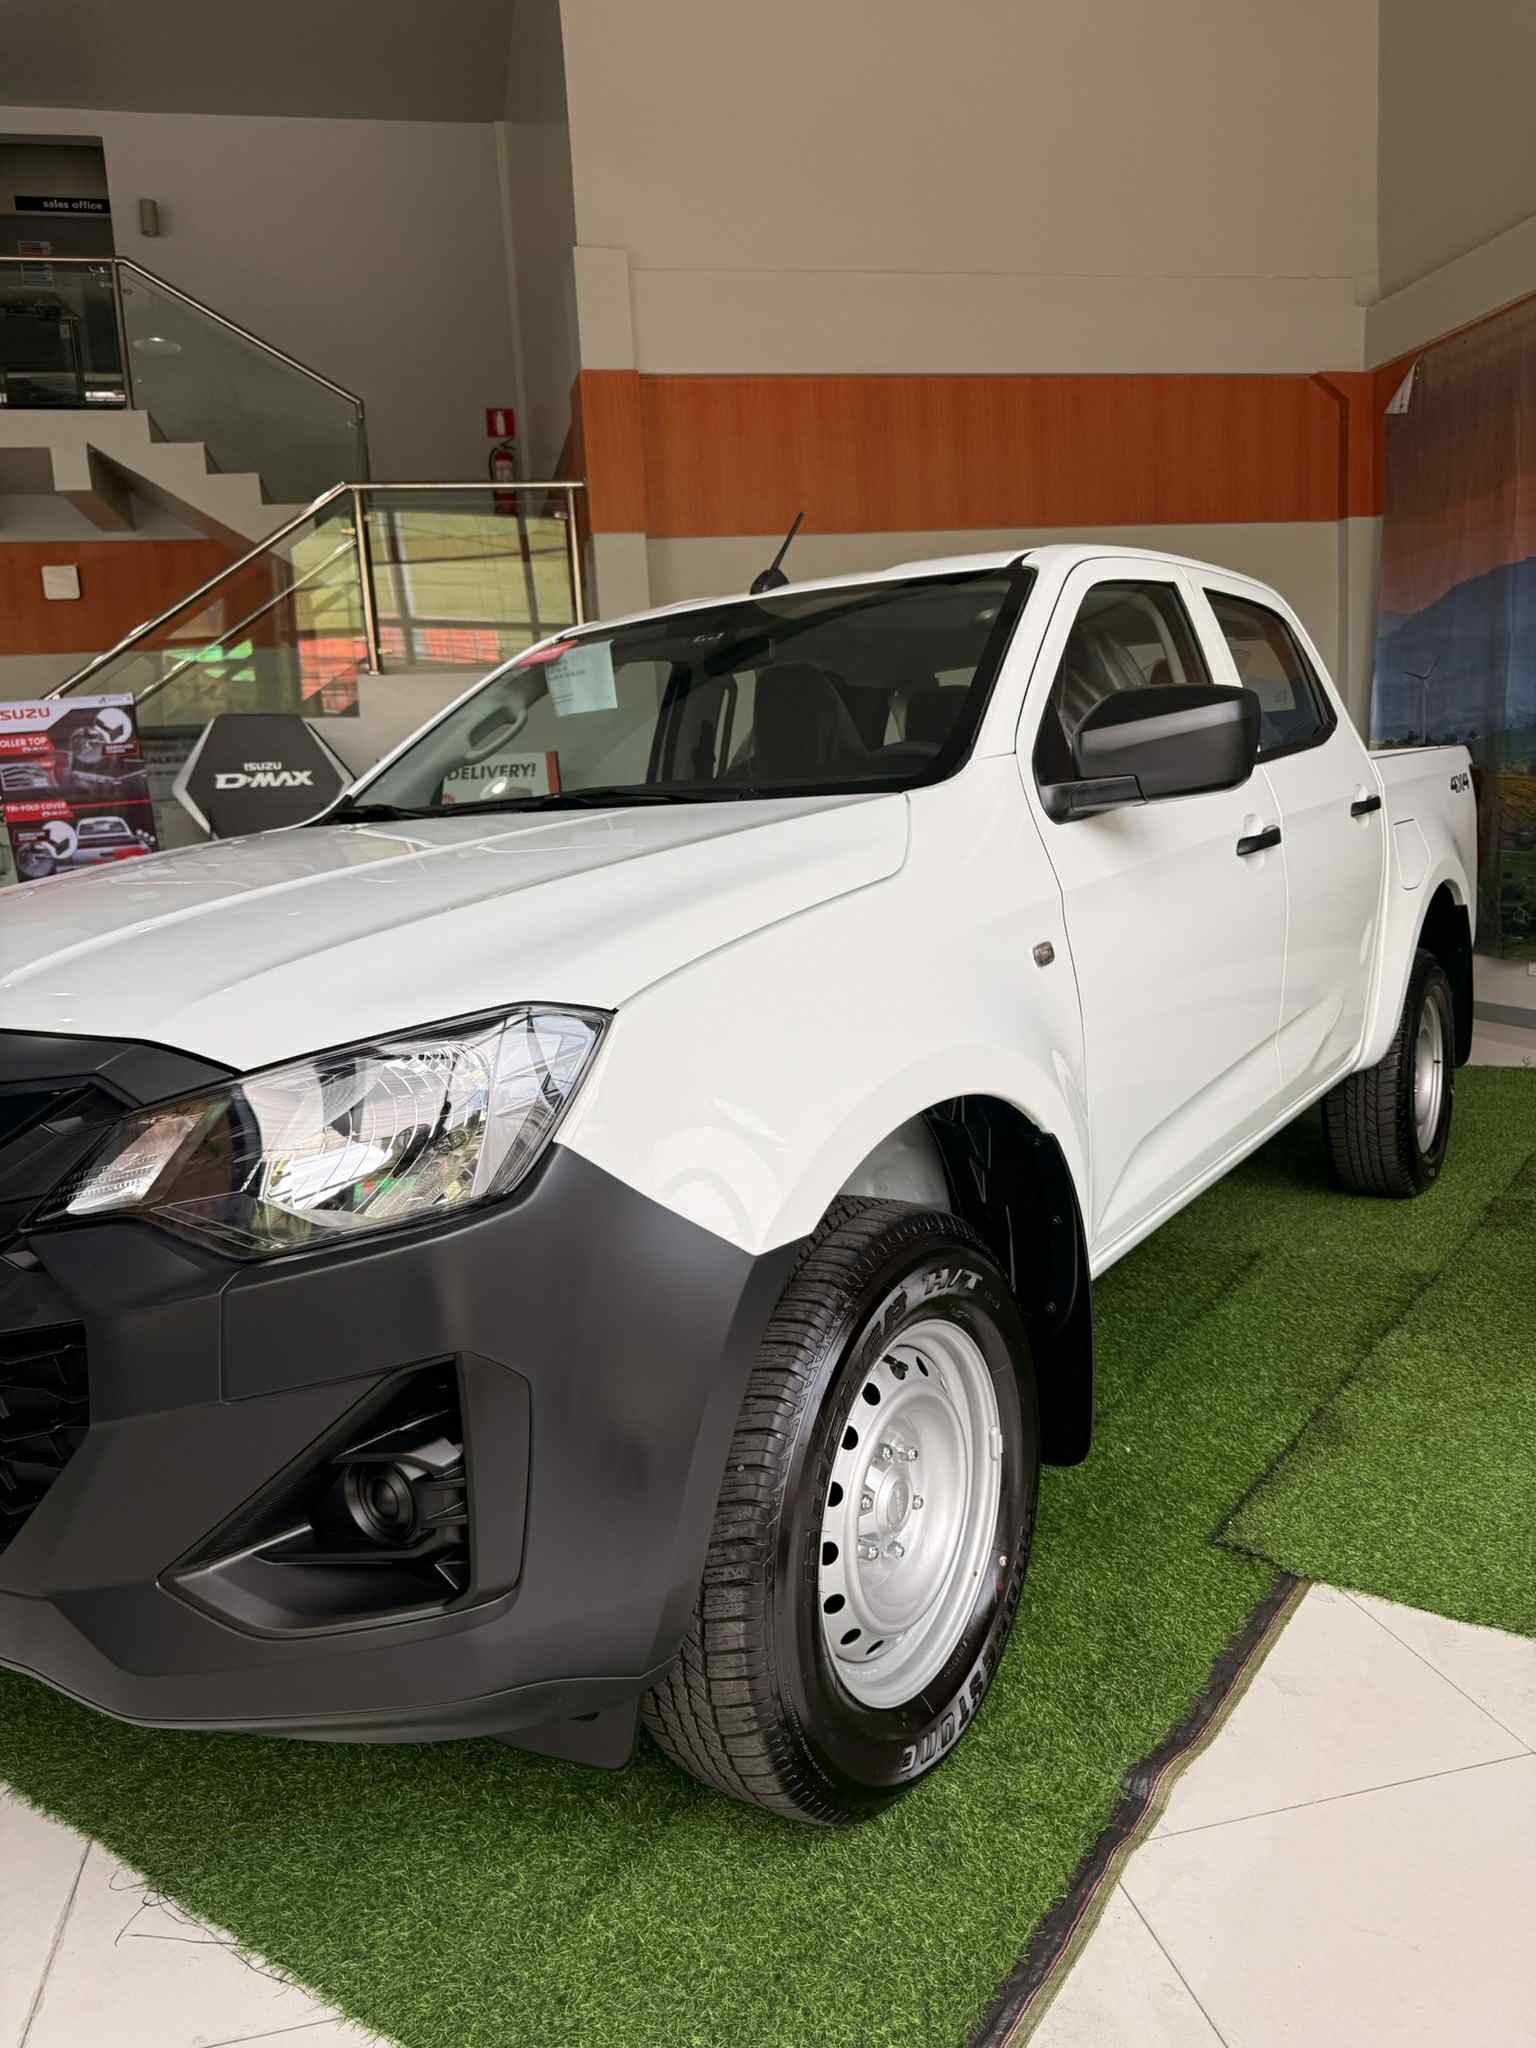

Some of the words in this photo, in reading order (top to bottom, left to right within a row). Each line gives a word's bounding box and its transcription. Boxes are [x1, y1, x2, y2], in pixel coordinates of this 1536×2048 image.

[43, 199, 69, 209] sales
[72, 201, 103, 210] office
[0, 707, 50, 721] SUZU
[0, 738, 26, 748] OLLER
[28, 736, 48, 745] TOP
[244, 762, 282, 770] ISUZU
[448, 762, 537, 781] DELIVERY!
[215, 771, 313, 789] D-MAX
[923, 1267, 983, 1295] H/T
